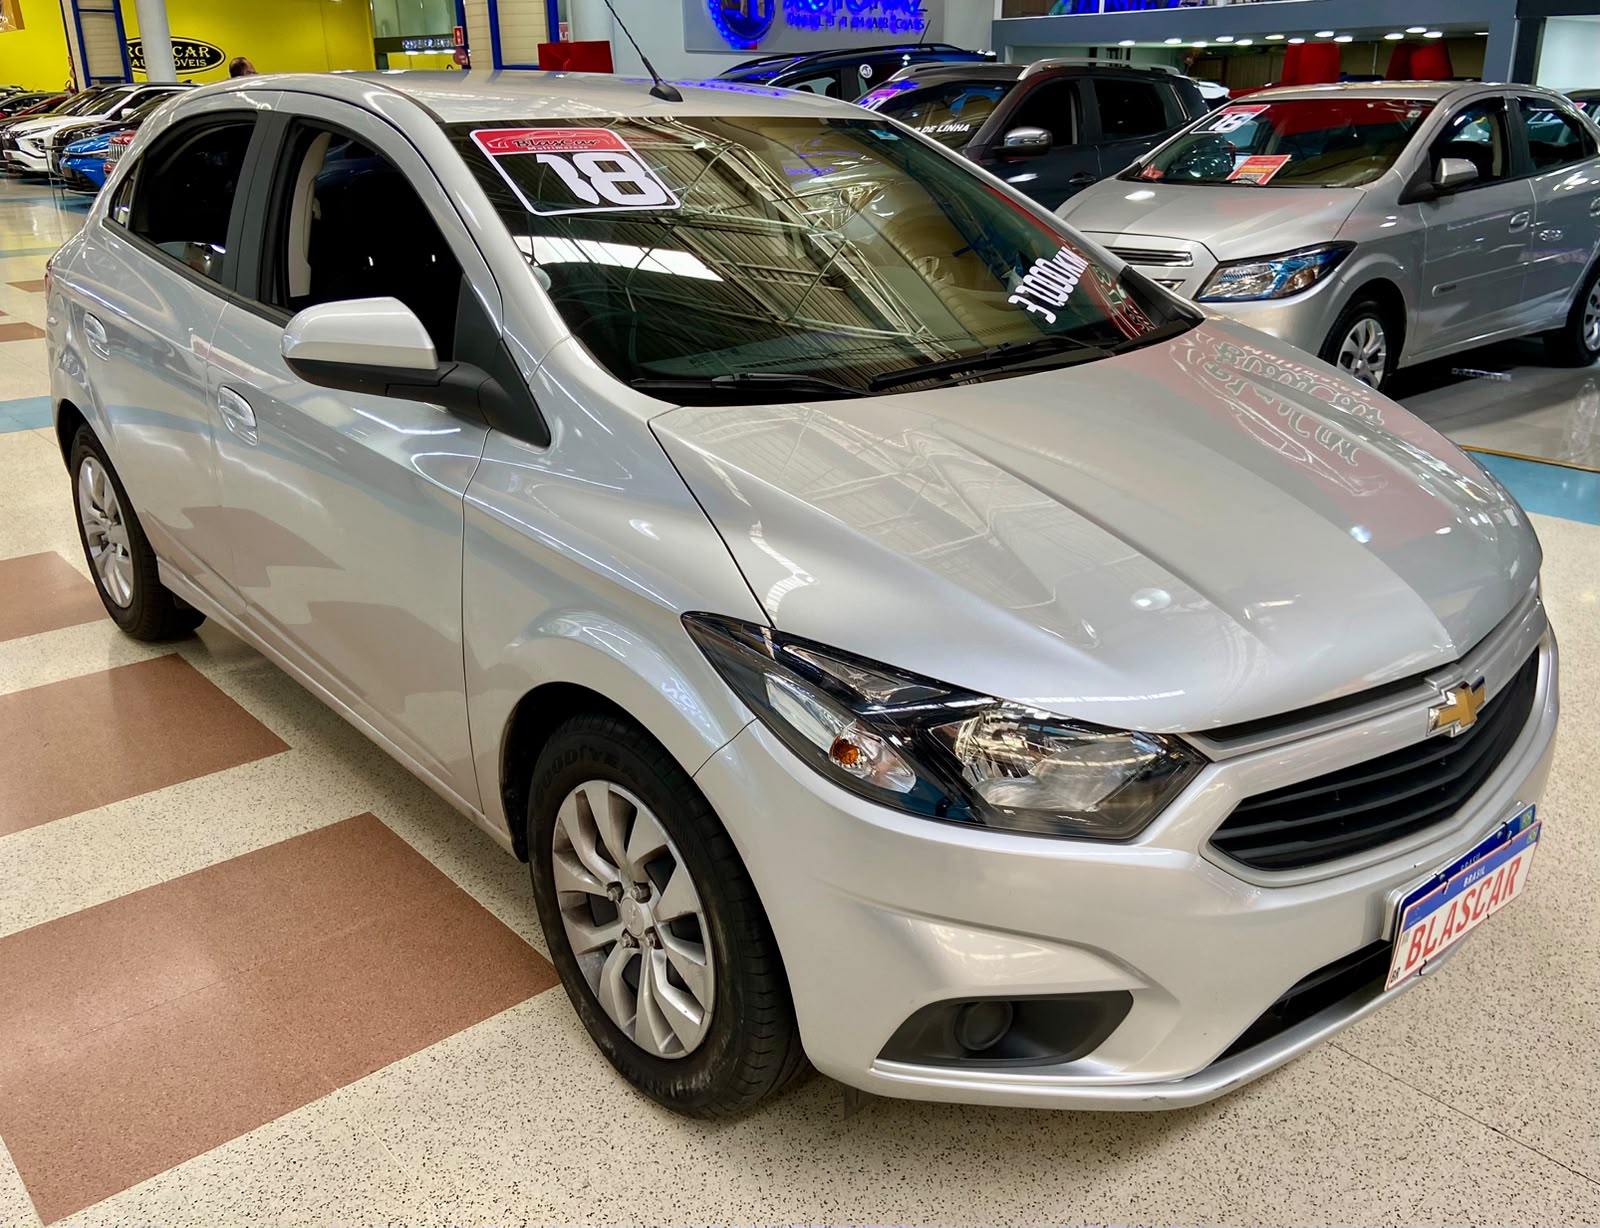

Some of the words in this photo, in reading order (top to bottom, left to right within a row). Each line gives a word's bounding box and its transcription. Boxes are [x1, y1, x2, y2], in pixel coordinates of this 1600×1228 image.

[936, 124, 970, 133] LINHA
[535, 152, 668, 206] 18
[1463, 865, 1486, 888] BRASIL
[1404, 856, 1522, 971] BLASCAR
